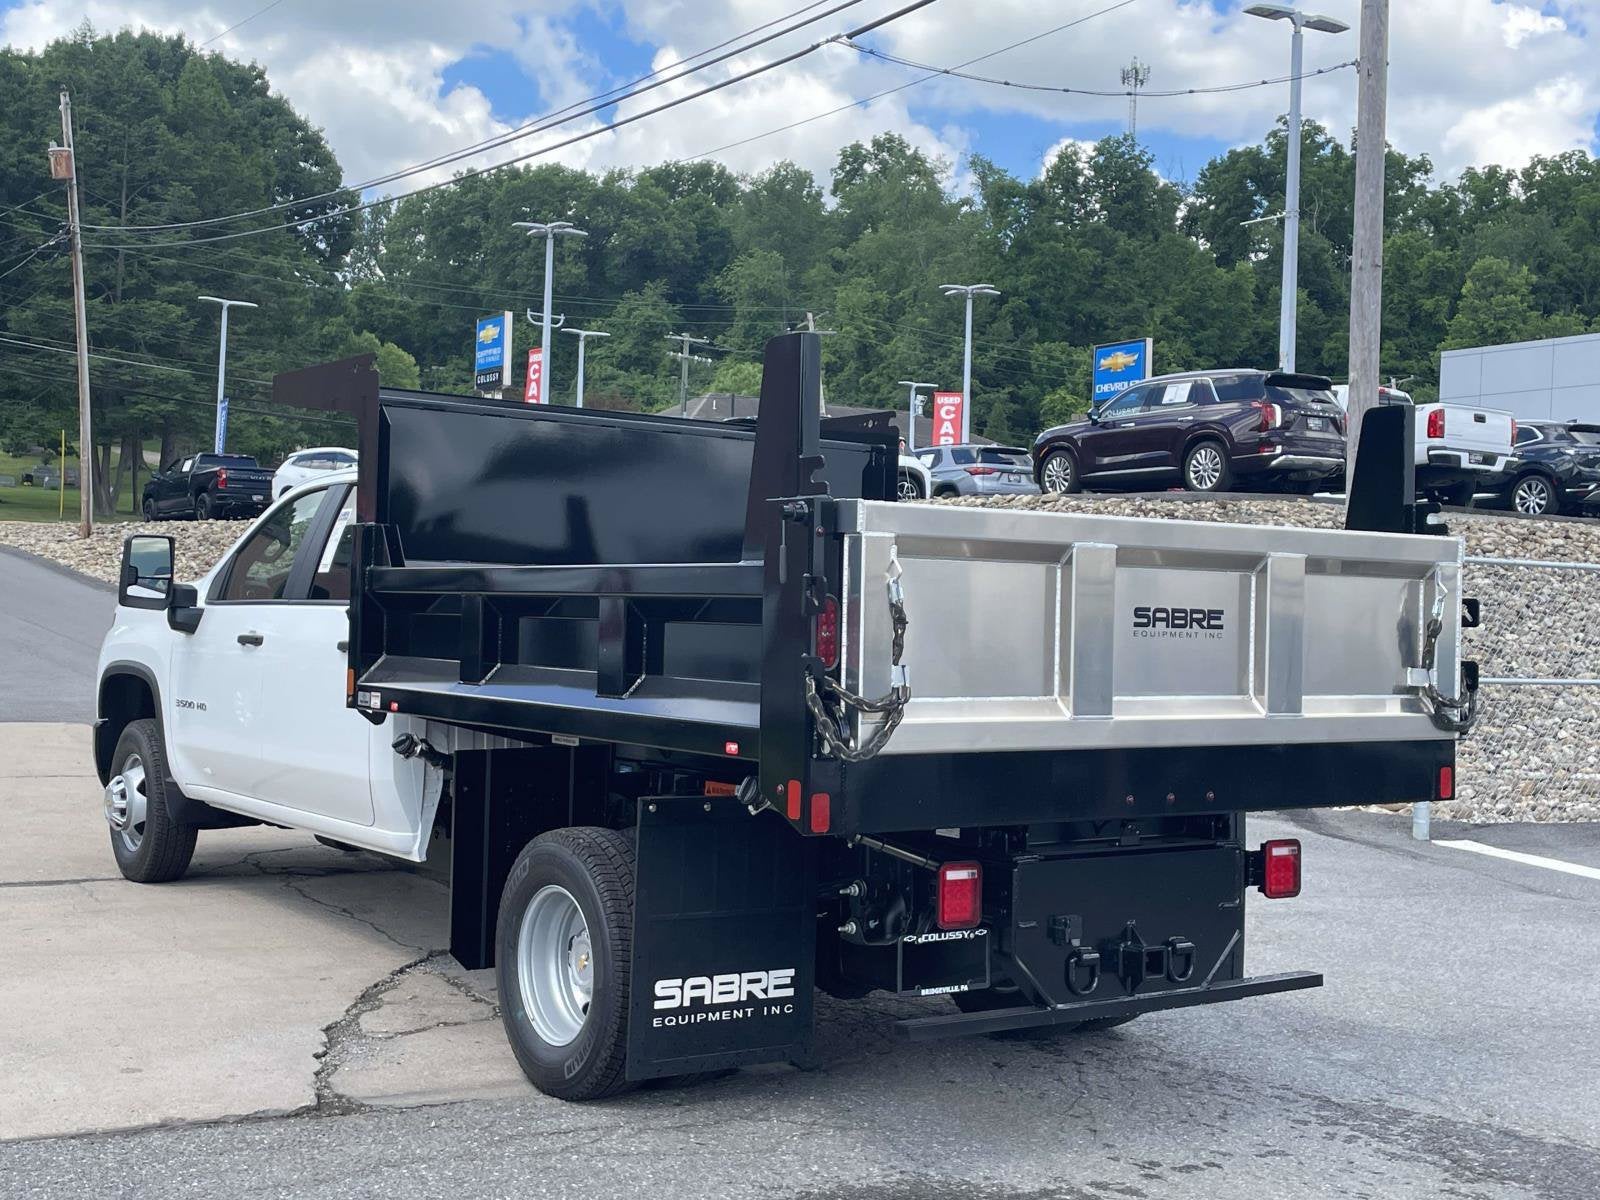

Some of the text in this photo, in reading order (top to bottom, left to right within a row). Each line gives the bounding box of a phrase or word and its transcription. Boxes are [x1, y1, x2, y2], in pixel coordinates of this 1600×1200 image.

[477, 372, 499, 384] COLUSSY
[1096, 380, 1141, 393] CHEVROLE
[937, 396, 960, 404] USED
[1133, 606, 1225, 630] SABRE
[1133, 630, 1199, 639] EQUIPMENT
[176, 698, 207, 711] 3500 HD
[921, 930, 971, 942] COLUSSY
[653, 968, 796, 1010] SABRE
[960, 984, 969, 992] PA
[652, 1003, 794, 1028] EQUIPMENT INC
